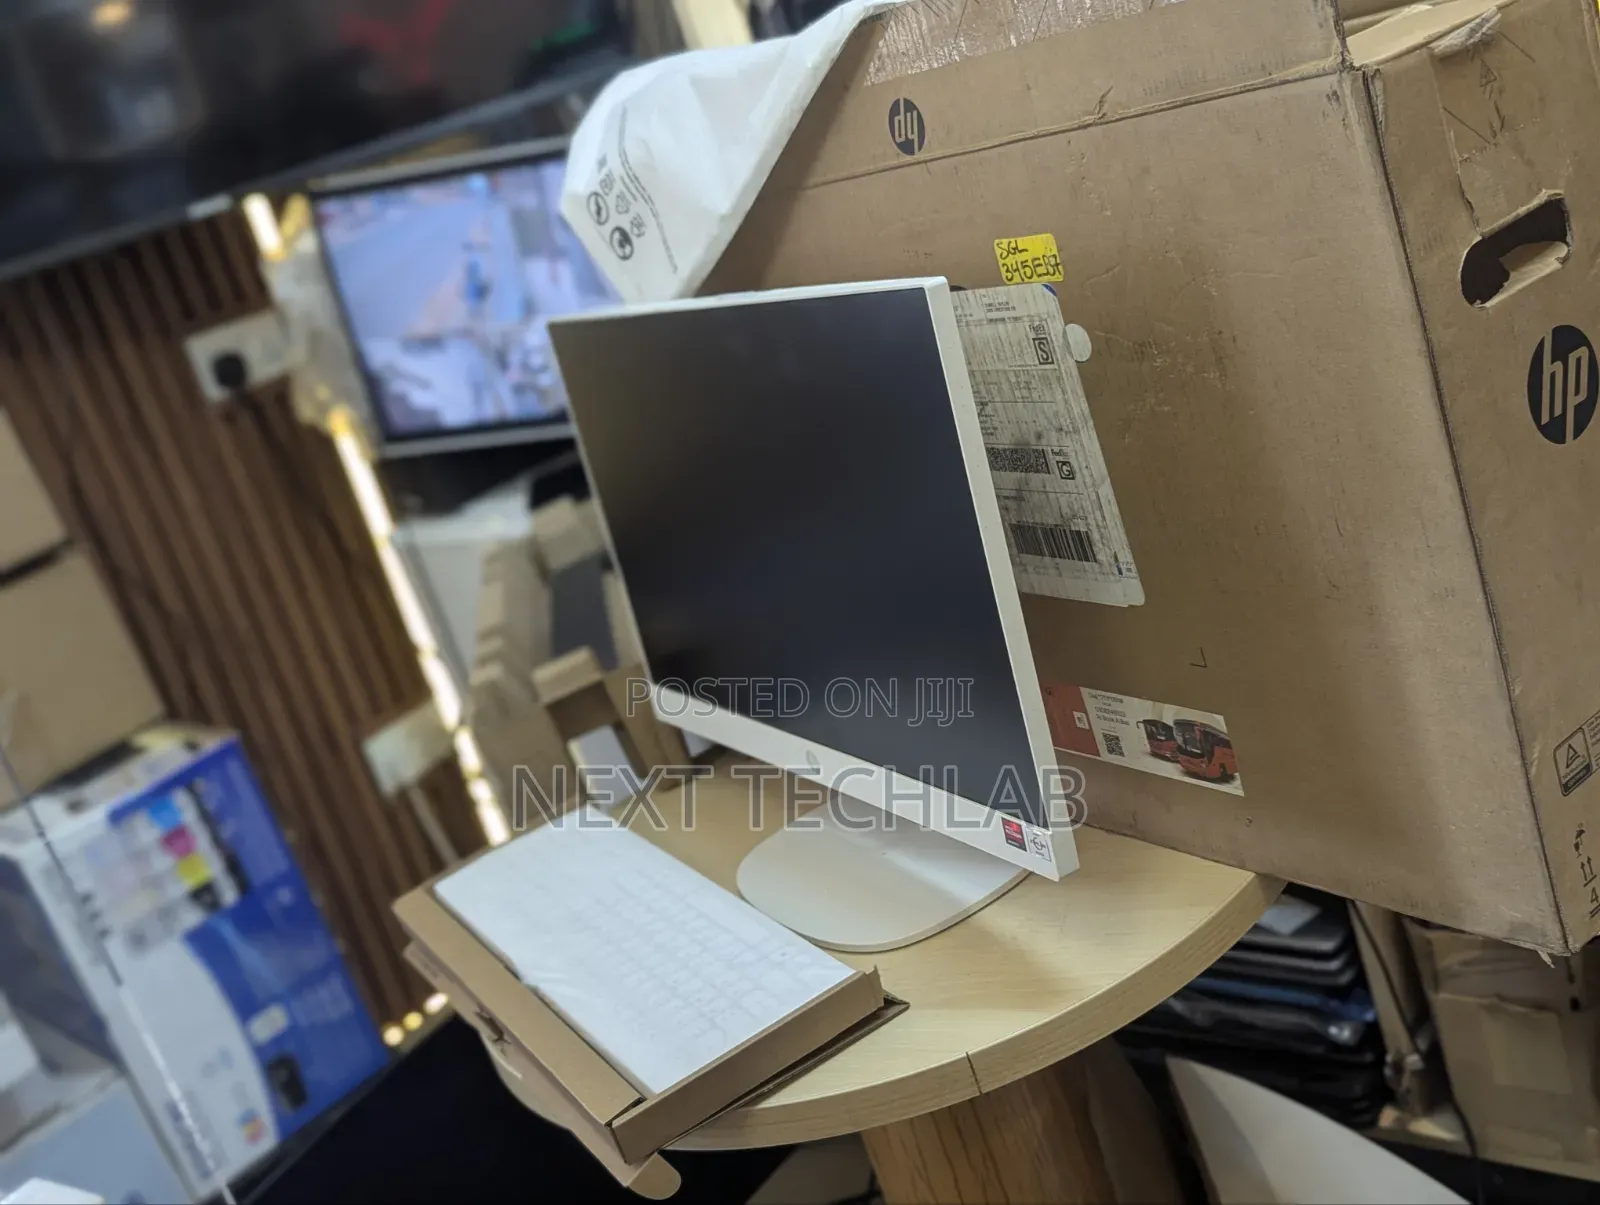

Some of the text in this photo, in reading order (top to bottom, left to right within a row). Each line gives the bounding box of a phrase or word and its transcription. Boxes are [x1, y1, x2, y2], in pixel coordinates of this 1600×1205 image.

[996, 239, 1029, 260] SGL
[1037, 341, 1050, 361] S
[1540, 325, 1590, 444] hp
[1060, 462, 1072, 477] G
[1590, 886, 1599, 904] 4
